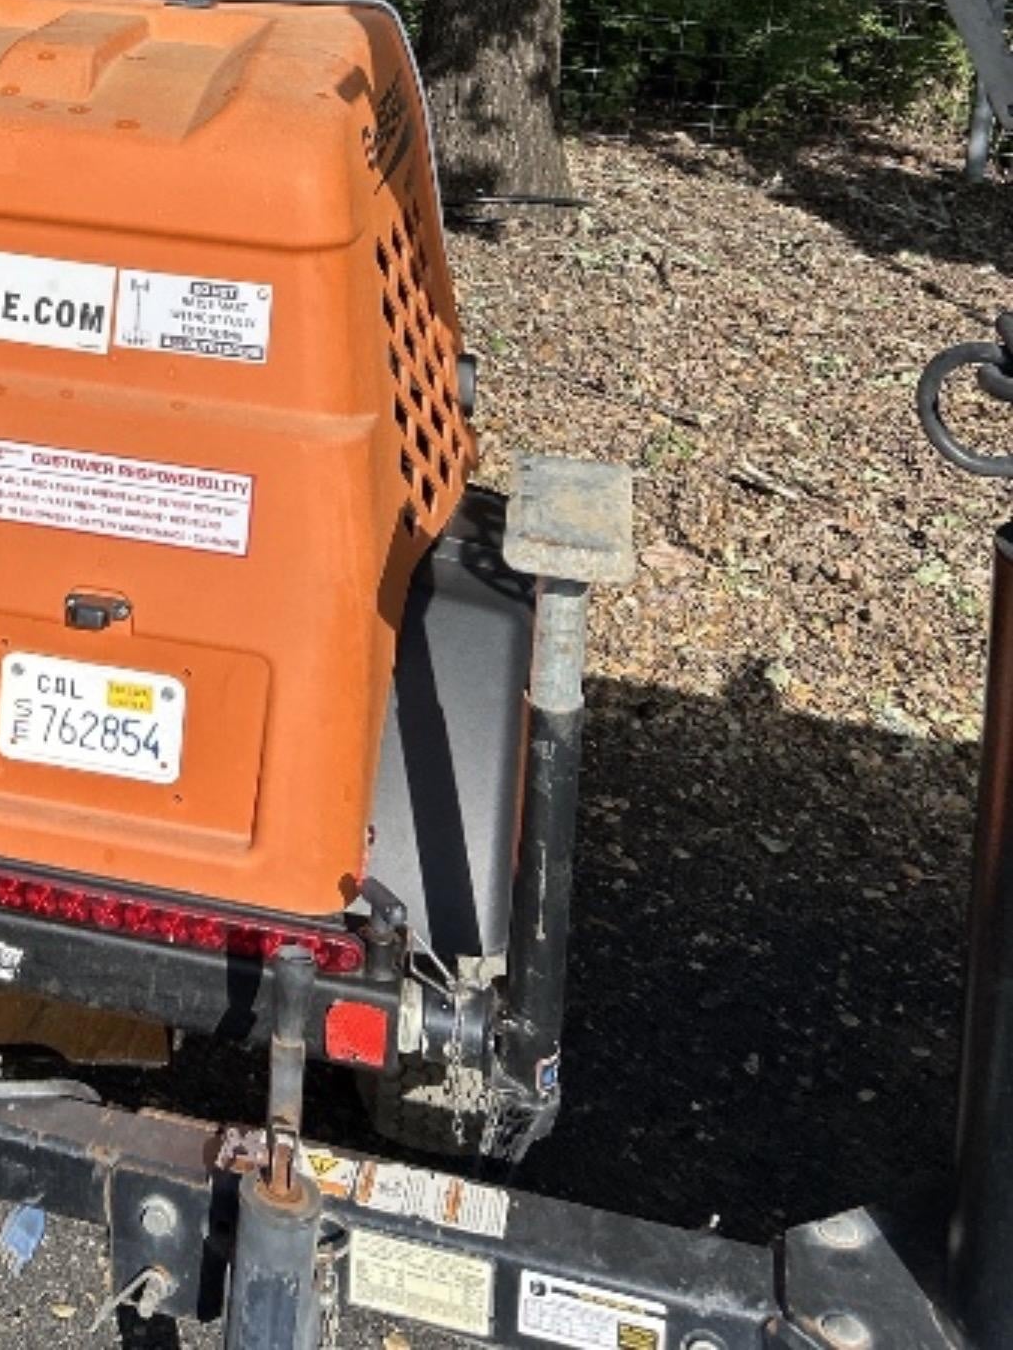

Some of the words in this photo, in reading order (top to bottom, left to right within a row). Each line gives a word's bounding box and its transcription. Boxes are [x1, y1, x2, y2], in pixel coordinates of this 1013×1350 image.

[31, 451, 115, 476] CUSTOMER
[117, 463, 249, 496] RESPONSIBILITY
[37, 674, 84, 700] CAL
[40, 703, 161, 761] 762854
